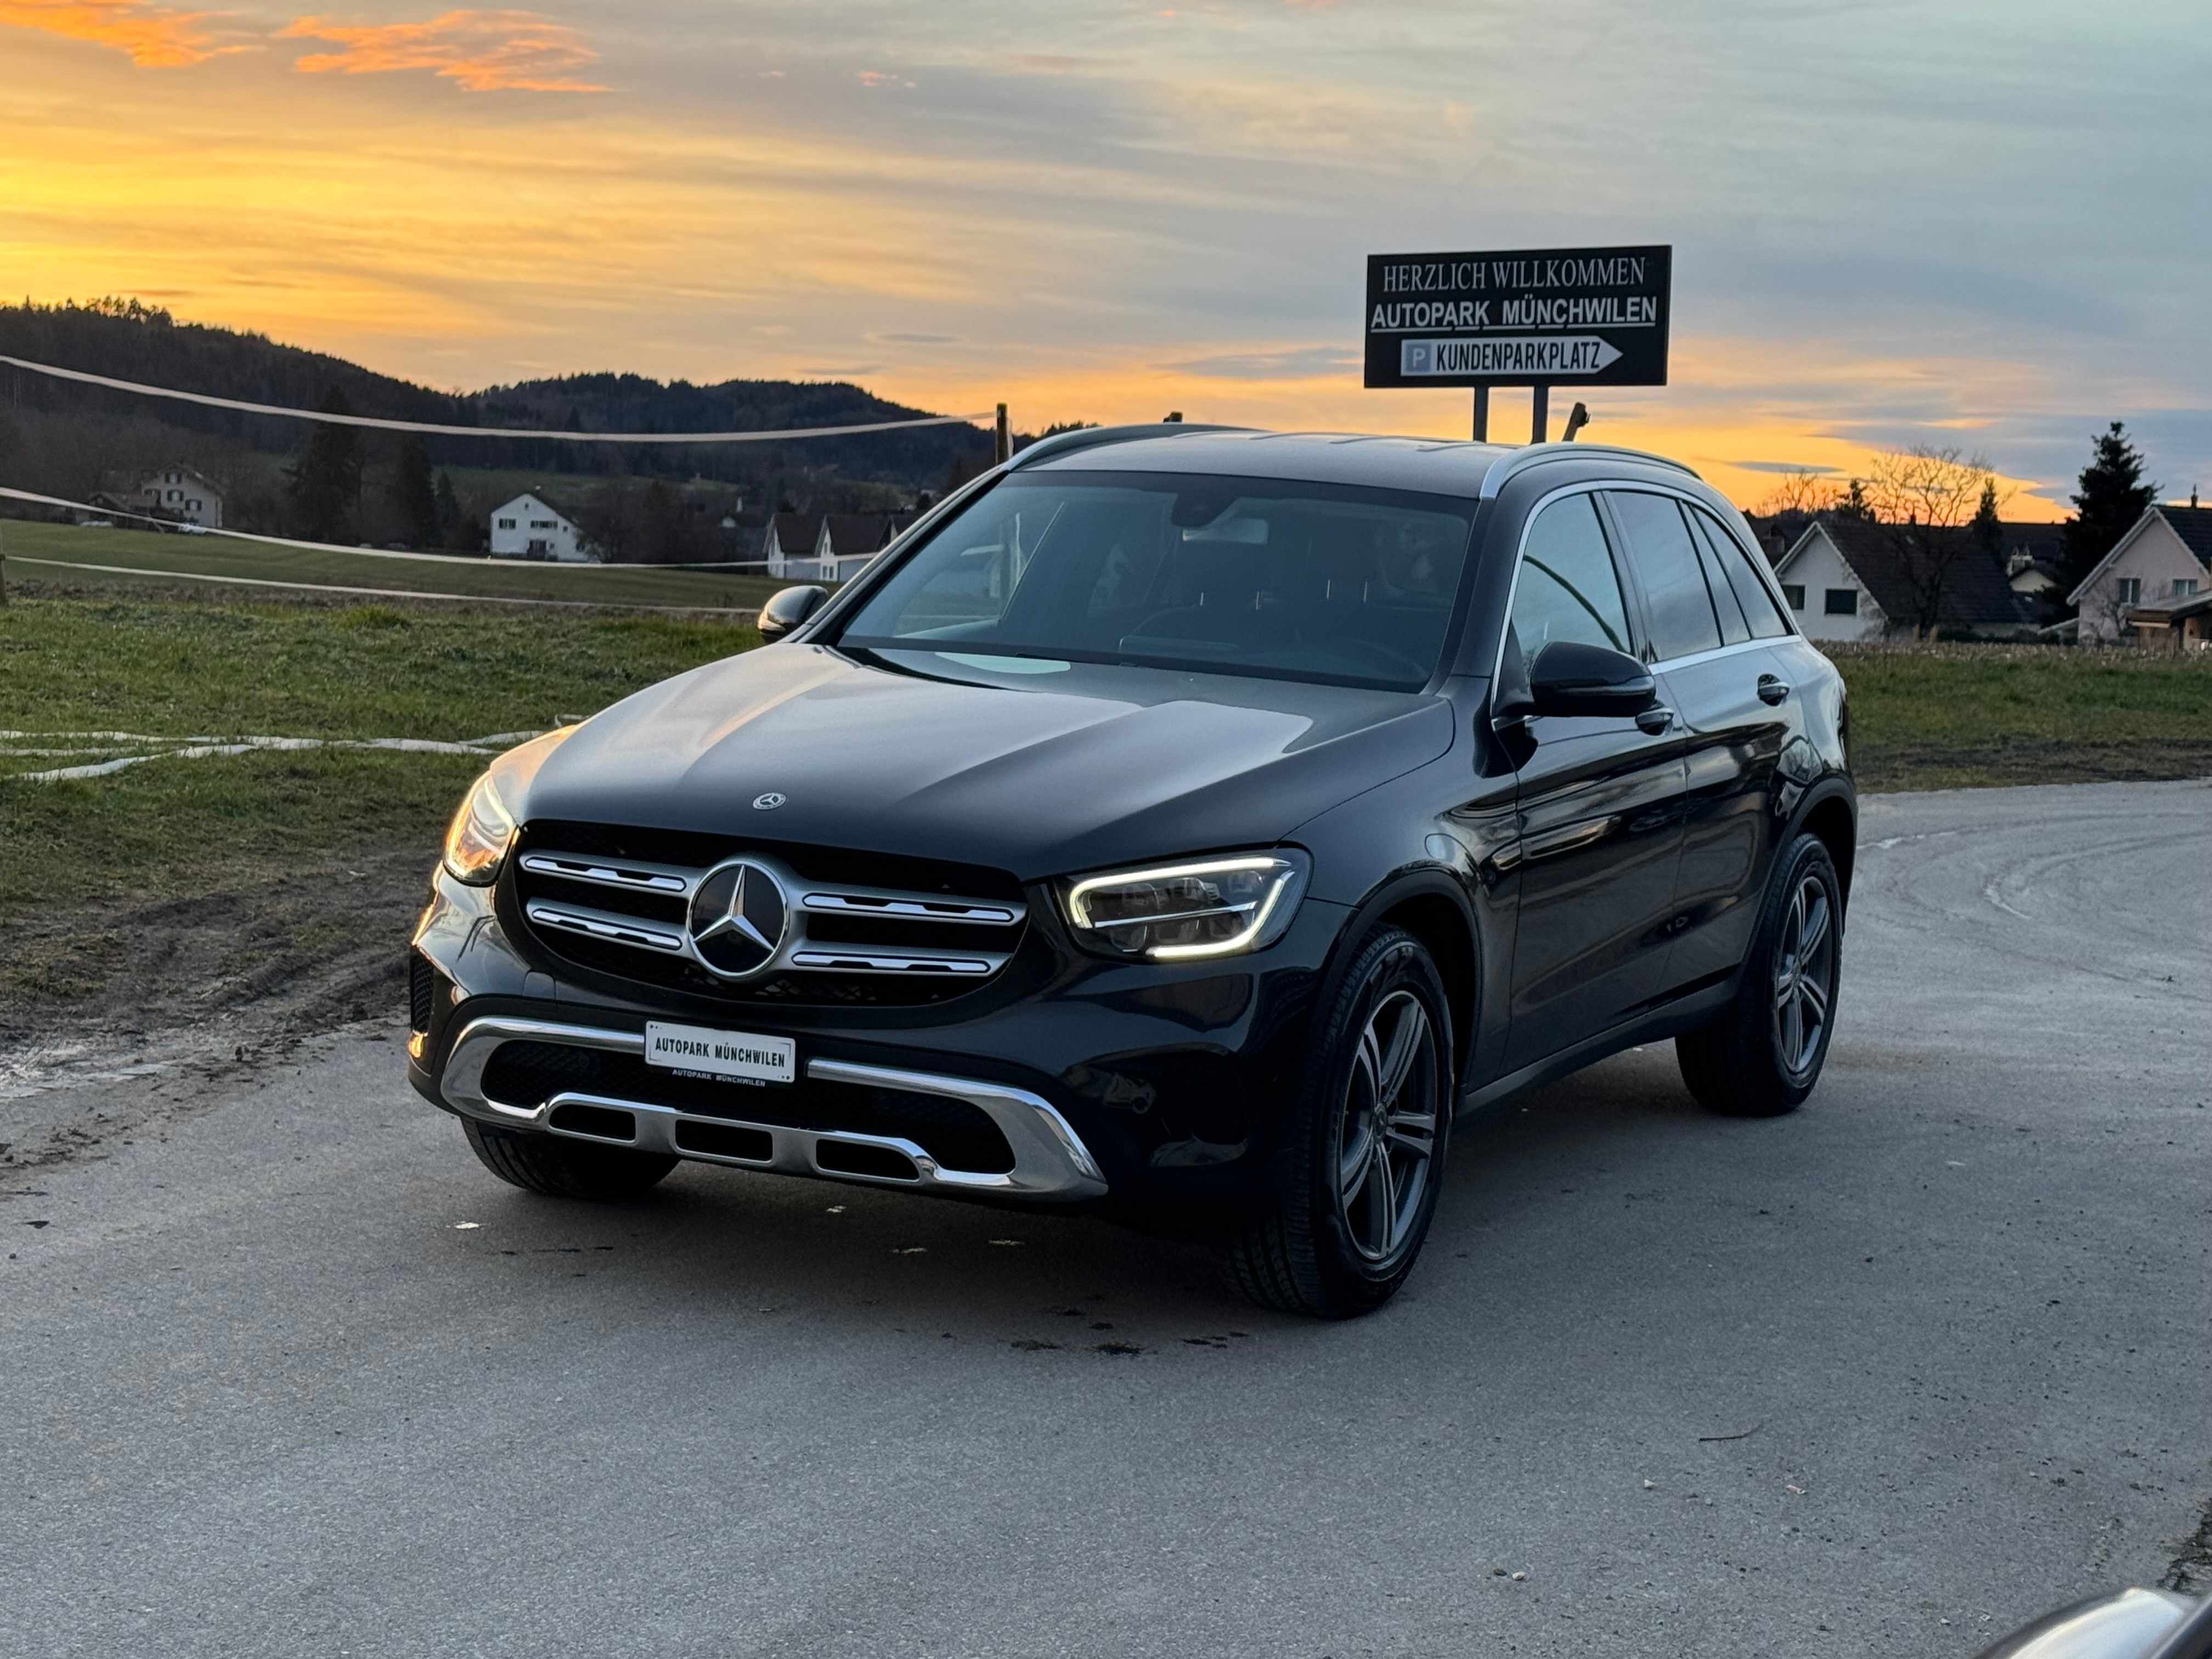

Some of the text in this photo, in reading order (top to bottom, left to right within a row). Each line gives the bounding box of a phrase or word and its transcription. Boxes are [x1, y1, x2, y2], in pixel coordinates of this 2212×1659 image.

[1384, 257, 1646, 292] HERZLICH WILLKOMMEN
[1371, 294, 1657, 328] AUTOPARK MÜNCHWILEN
[1413, 348, 1425, 368] P
[1436, 341, 1601, 371] KUNDENPARKPLATZ
[656, 1037, 785, 1068] AUTOPARK MÜNCHWILEN
[672, 1069, 765, 1087] AUTOPARK MÜNCHWILEN
